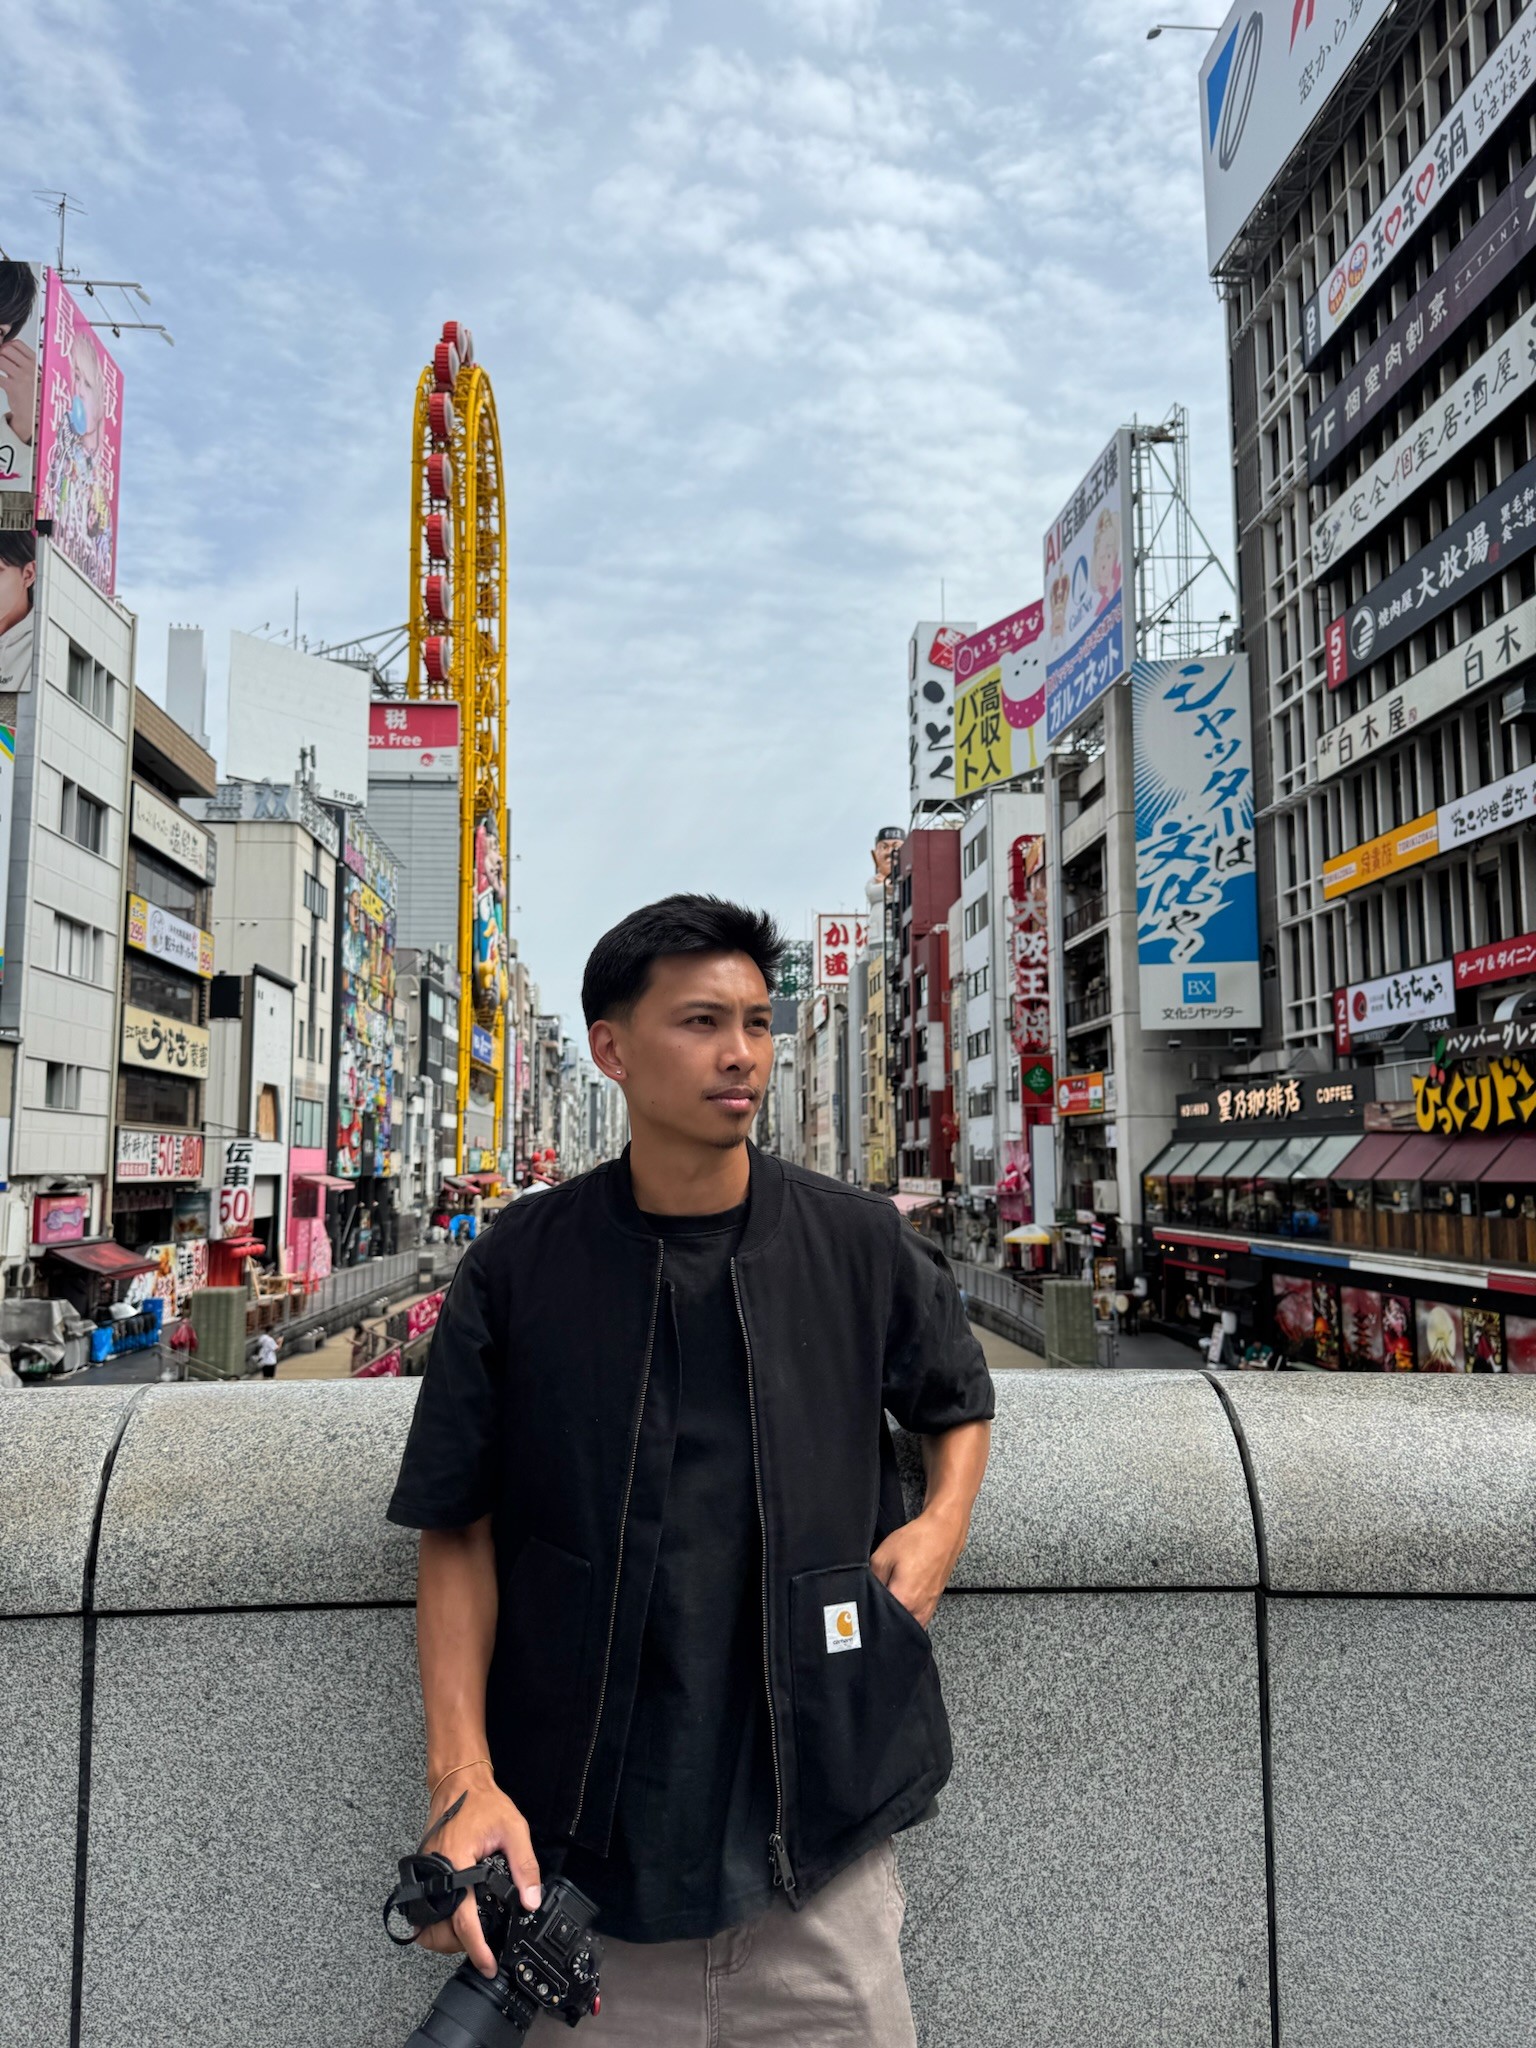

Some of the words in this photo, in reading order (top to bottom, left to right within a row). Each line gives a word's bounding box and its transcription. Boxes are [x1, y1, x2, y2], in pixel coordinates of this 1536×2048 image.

[1472, 12, 1536, 112] しゃぶしゃ
[1475, 54, 1532, 136] すき焼き
[1455, 216, 1520, 294] KATANA
[1305, 305, 1316, 355] 8F
[1344, 287, 1448, 423] 個室肉割烹
[1310, 407, 1337, 462] 7F
[1350, 347, 1519, 532] 完全個室居酒屋
[1500, 486, 1536, 522] 黒毛和
[1377, 588, 1414, 630] 焼肉屋
[1415, 520, 1490, 610] 大牧場
[1331, 625, 1342, 680] 5F
[1463, 622, 1536, 689] 白木
[1050, 638, 1120, 732] ガルフネット
[368, 734, 385, 746] ax
[389, 732, 423, 747] Free
[385, 708, 408, 731] 税
[958, 689, 979, 790] バイト
[980, 679, 1001, 782] 高収入
[1319, 731, 1334, 755] 4F
[1338, 696, 1407, 766] 白木屋
[1008, 892, 1050, 1044] 大阪王将
[1187, 980, 1211, 995] BX
[1162, 1005, 1244, 1020] 文化シャッター
[1337, 998, 1347, 1046] 2F
[1217, 1079, 1302, 1123] 星乃珈琲店
[1316, 1084, 1355, 1104] COFFEE
[158, 1134, 174, 1176] 50
[223, 1142, 253, 1188] 伝串
[219, 1188, 250, 1223] 50
